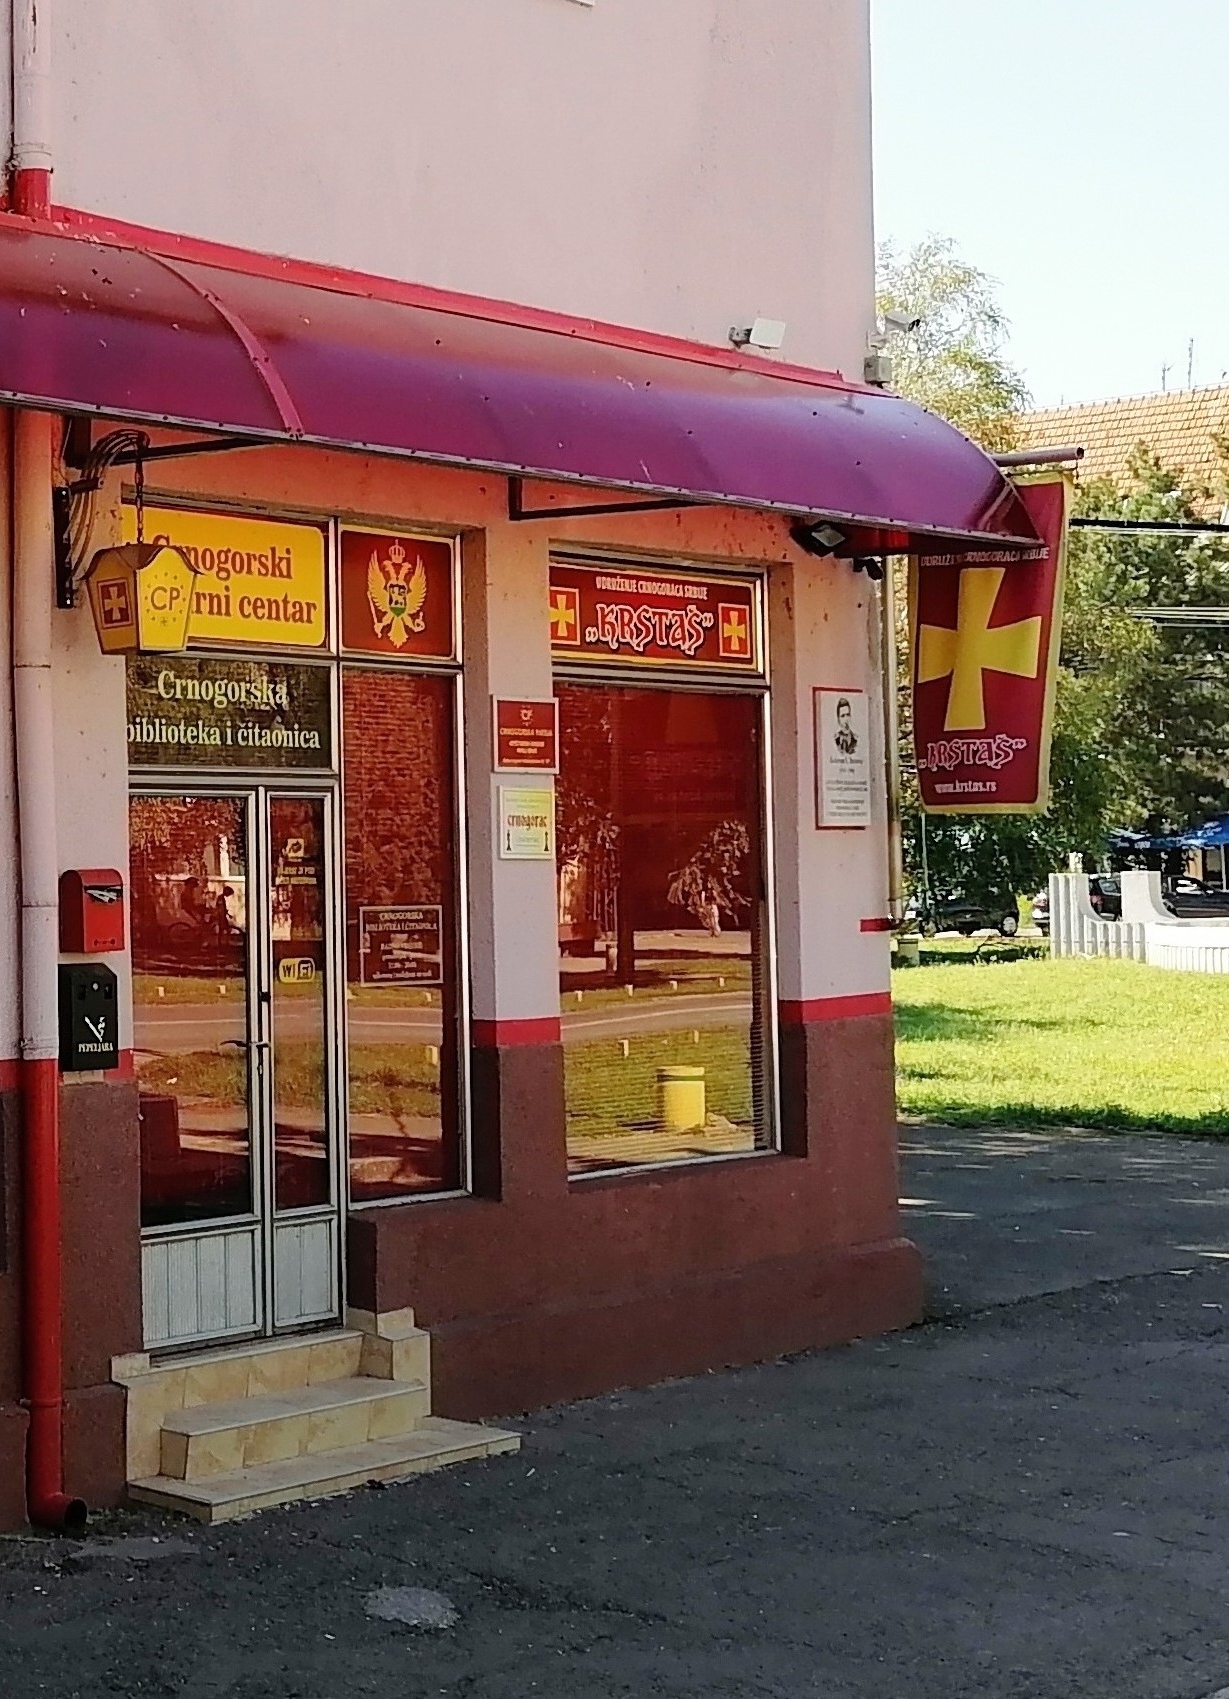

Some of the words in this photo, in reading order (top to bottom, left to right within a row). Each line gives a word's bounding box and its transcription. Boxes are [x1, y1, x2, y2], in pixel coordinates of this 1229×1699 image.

[153, 534, 293, 581] nogorski
[150, 585, 181, 611] CP
[238, 591, 317, 625] centar
[157, 670, 289, 708] Crnogorska
[226, 723, 233, 745] i
[237, 721, 321, 749] čitaonica
